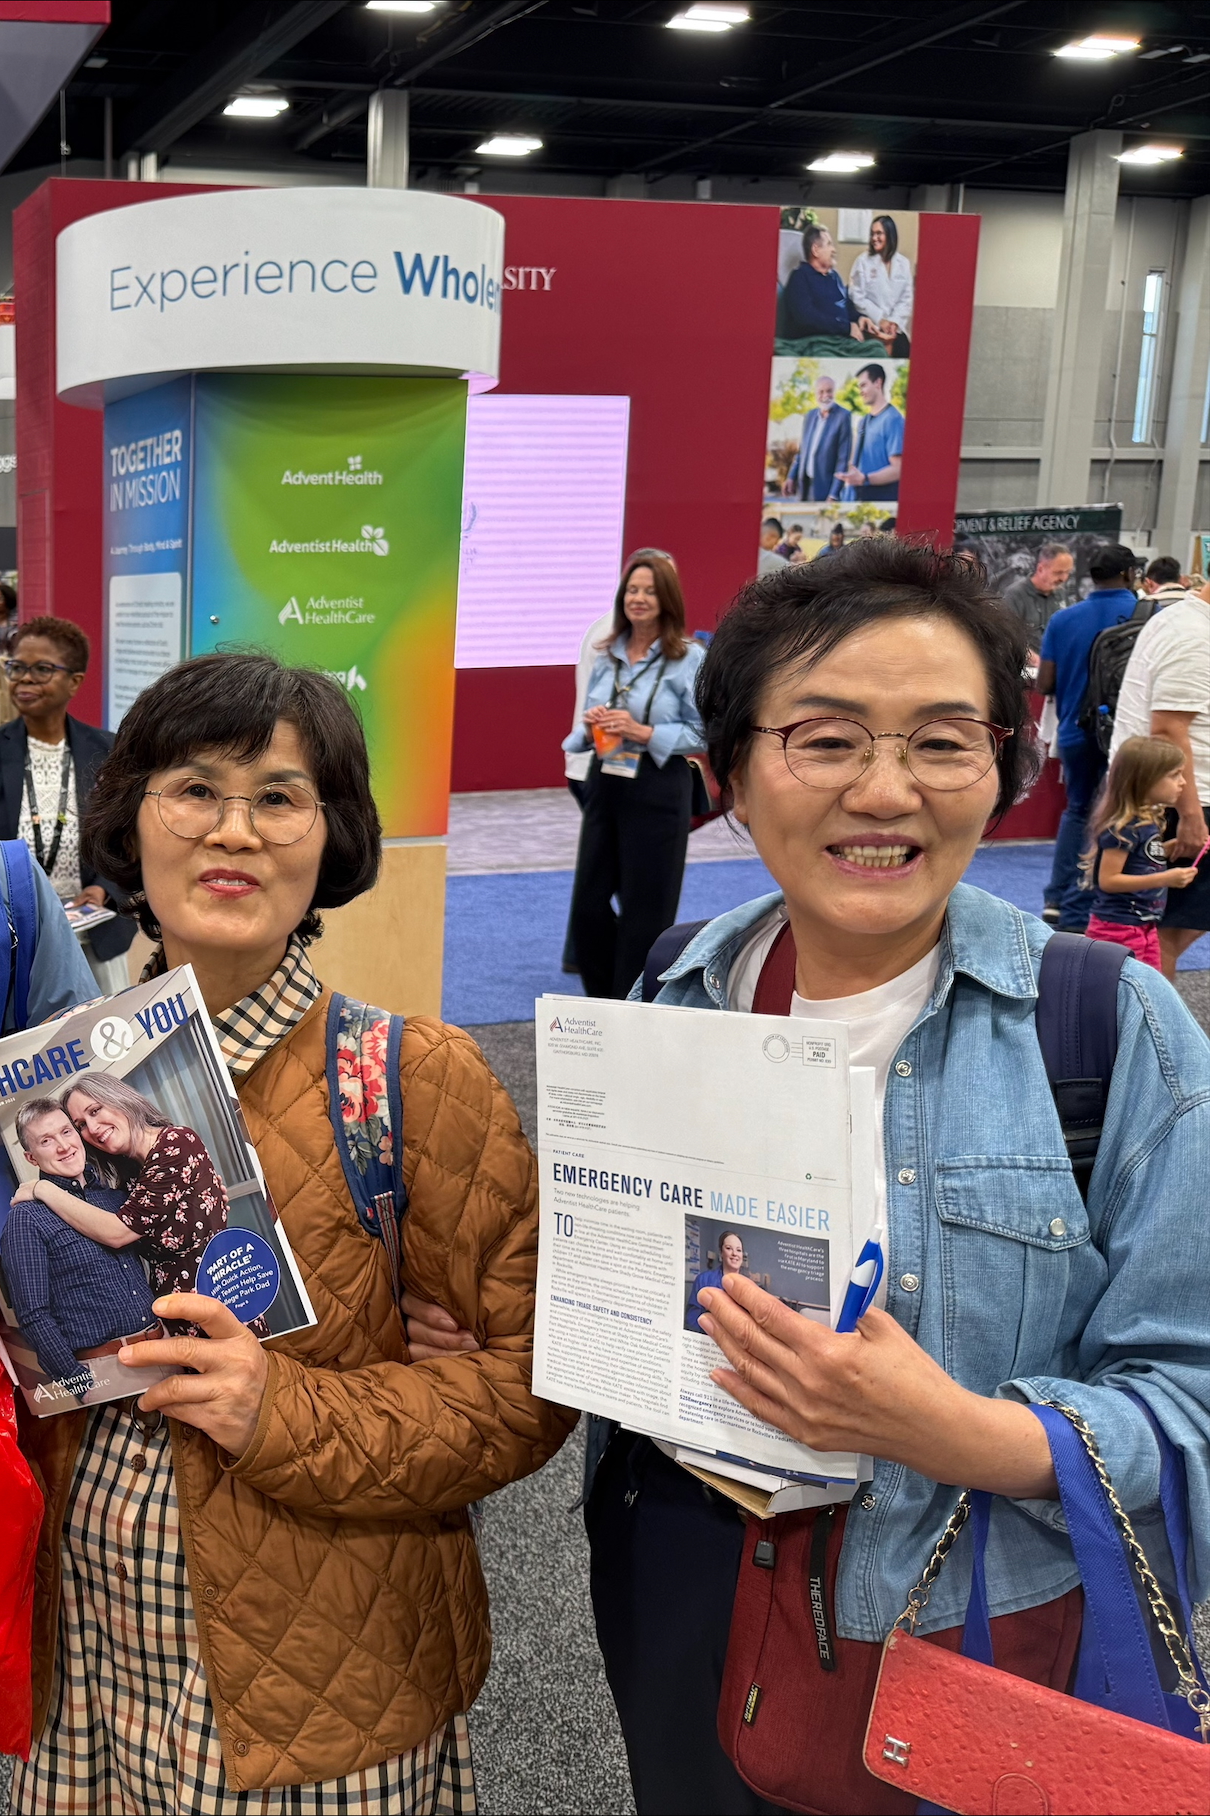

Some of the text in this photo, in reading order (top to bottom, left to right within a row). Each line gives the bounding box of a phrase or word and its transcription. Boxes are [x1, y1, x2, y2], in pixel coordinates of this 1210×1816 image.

[109, 251, 378, 313] Experience
[501, 266, 557, 291] SITY
[110, 429, 183, 477] TOGETHER
[110, 468, 181, 512] IN MISSION
[996, 515, 1031, 531] RELIEF
[1031, 514, 1080, 530] AGENCY
[306, 595, 364, 609] Adventist
[305, 610, 376, 625] HealthCare
[99, 1020, 130, 1060] &
[136, 993, 188, 1041] YOU
[564, 1017, 596, 1027] Adventist
[564, 1026, 603, 1037] HealthCare
[552, 1148, 570, 1156] PATIENT
[553, 1163, 831, 1232] EMERGENCY CARE MADE EASIER
[553, 1196, 577, 1206] Adventist
[578, 1201, 607, 1212] HealthCare
[576, 1192, 608, 1204] technologies
[619, 1200, 639, 1211] helping
[553, 1211, 574, 1238] TO
[230, 1246, 244, 1259] OF
[246, 1242, 255, 1253] A
[221, 1273, 239, 1287] Quick
[221, 1283, 240, 1298] Teams
[240, 1276, 257, 1288] Help
[257, 1270, 274, 1280] Save
[239, 1285, 256, 1298] Park
[255, 1280, 271, 1291] Dad
[550, 1294, 652, 1325] ENHANCING TRIAGE SAFETY AND CONSISTENCY
[51, 1369, 98, 1389] Adventist
[53, 1376, 111, 1399] HealthCare
[810, 1576, 830, 1660] THEREDFACE
